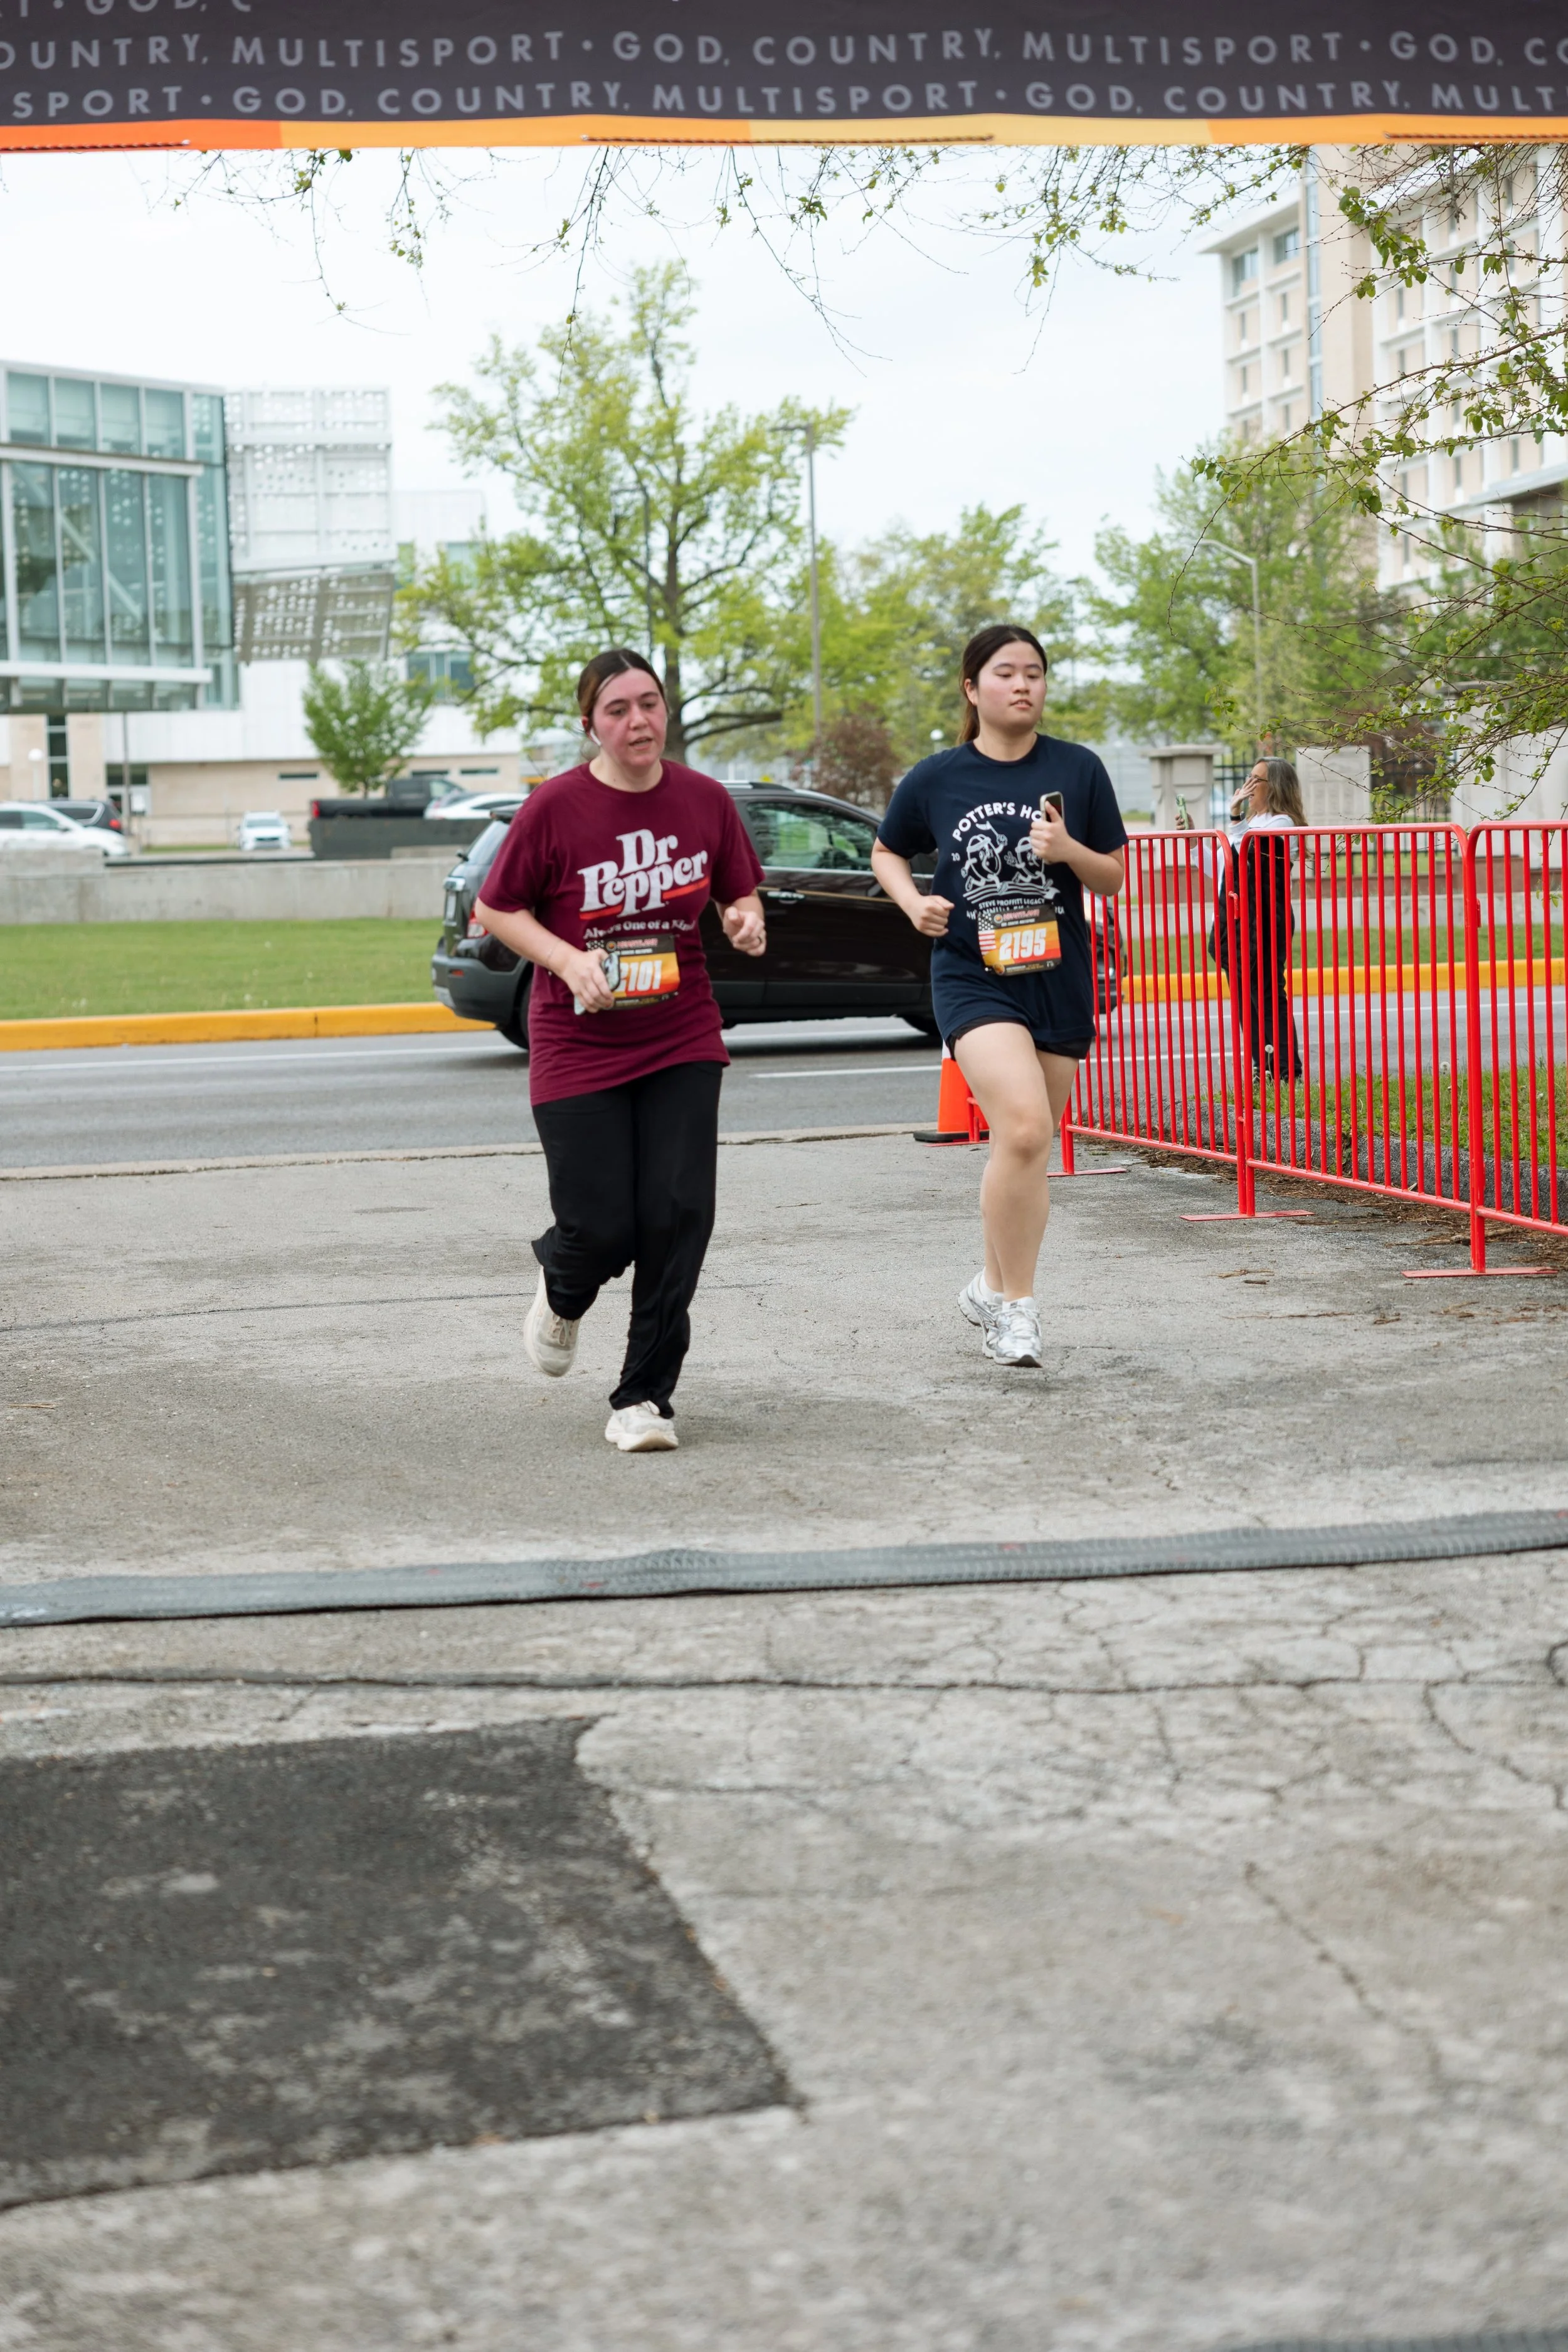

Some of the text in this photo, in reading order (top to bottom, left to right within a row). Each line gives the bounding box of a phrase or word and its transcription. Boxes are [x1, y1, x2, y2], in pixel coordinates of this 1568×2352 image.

[231, 31, 563, 68] MULTISPORT
[612, 31, 730, 67] GOD,
[752, 28, 1001, 66] COUNTRY,
[1022, 32, 1340, 66] MULTISPORT
[1389, 31, 1503, 66] GOD,
[11, 80, 1568, 117] SPORT GOD, COUNTRY, MULTISPORT GOD, COUNTRY, MULT
[952, 802, 1042, 842] POTTER'S HO
[616, 828, 679, 876] Dr
[951, 852, 960, 862] 20
[577, 849, 708, 918] Pepper
[978, 899, 996, 909] STEVE
[583, 924, 622, 940] Alwys
[623, 920, 646, 931] One
[647, 919, 661, 930] of
[662, 921, 670, 930] a
[999, 928, 1047, 961] 2195
